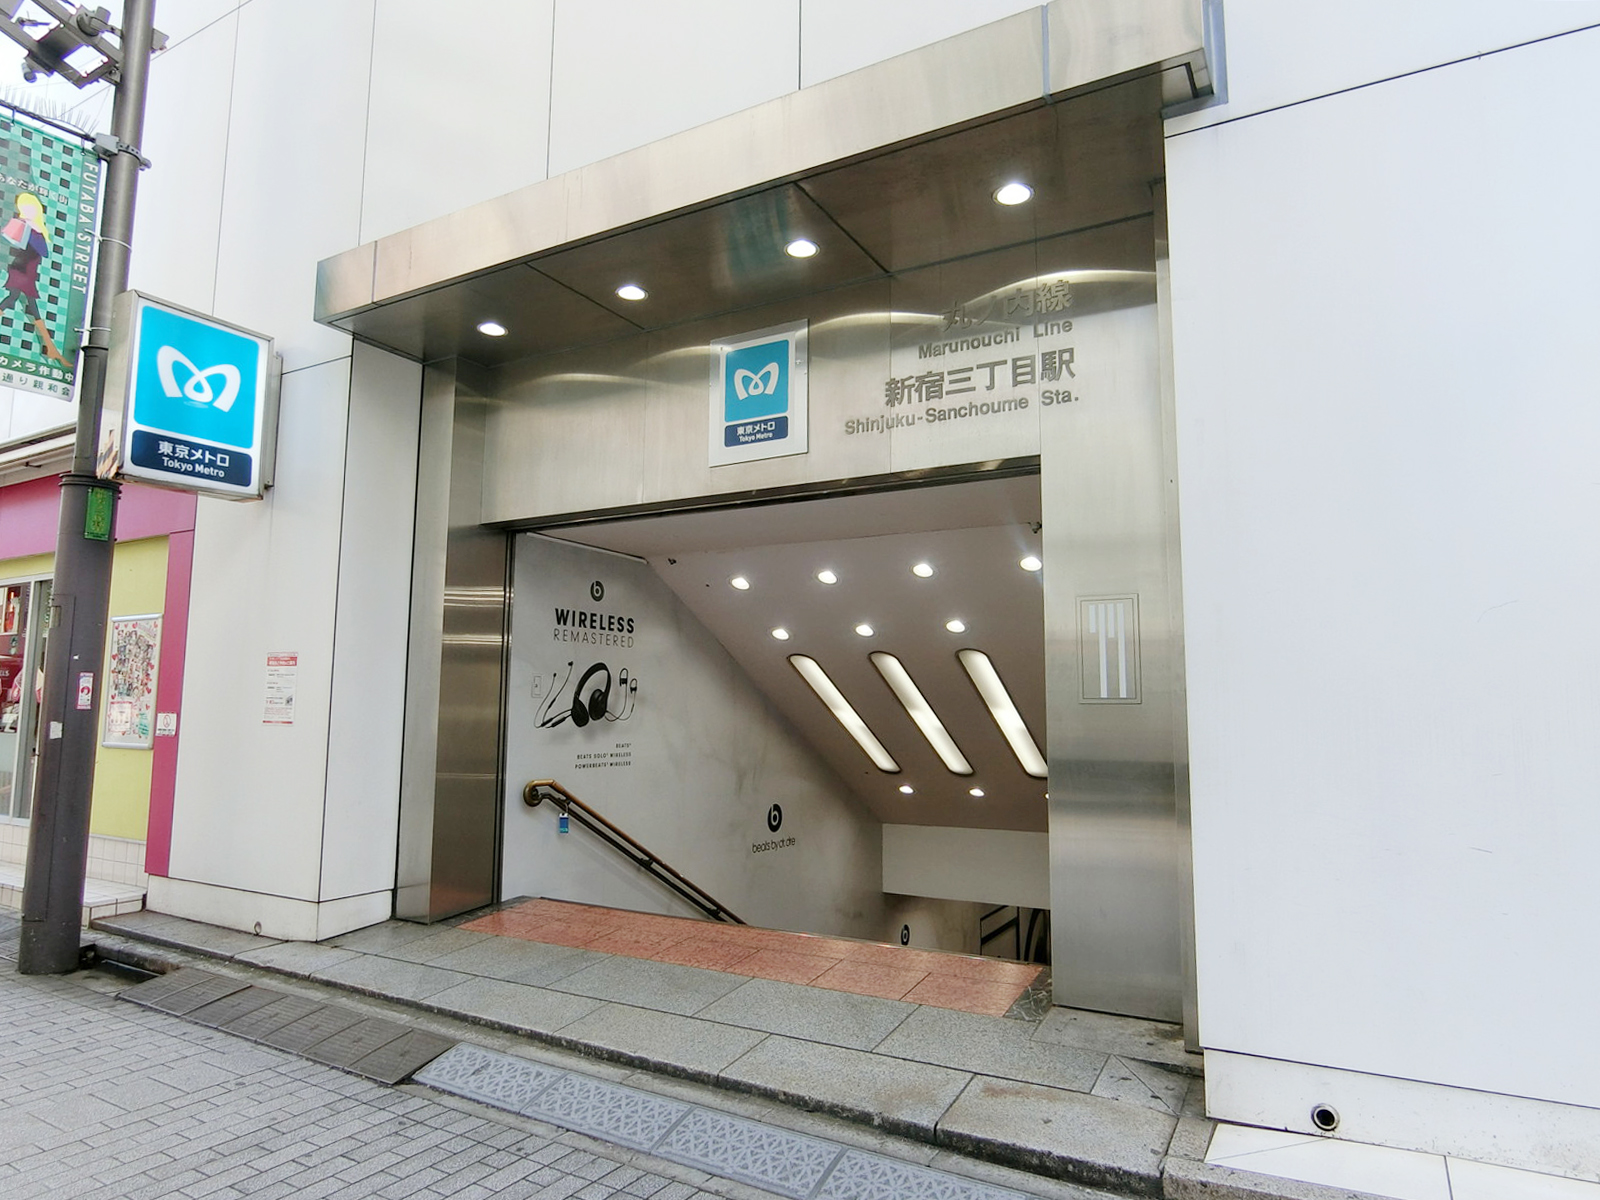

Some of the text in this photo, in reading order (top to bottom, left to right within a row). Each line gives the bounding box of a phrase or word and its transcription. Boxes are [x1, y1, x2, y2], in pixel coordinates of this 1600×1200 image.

[942, 279, 1074, 332] 丸ノ内線
[918, 319, 1074, 359] Marunouchi Line
[884, 347, 1077, 408] 新宿三丁目駅
[844, 387, 1080, 436] Shinjuku-Sanchoume Sta.
[737, 421, 775, 435] 東京メトロ
[756, 432, 773, 440] Metro
[157, 440, 231, 468] 東京メトロ
[162, 457, 226, 479] Tokyo Metro
[554, 607, 635, 634] WIRELESS
[553, 628, 635, 649] REMASTERED
[752, 841, 770, 853] beats
